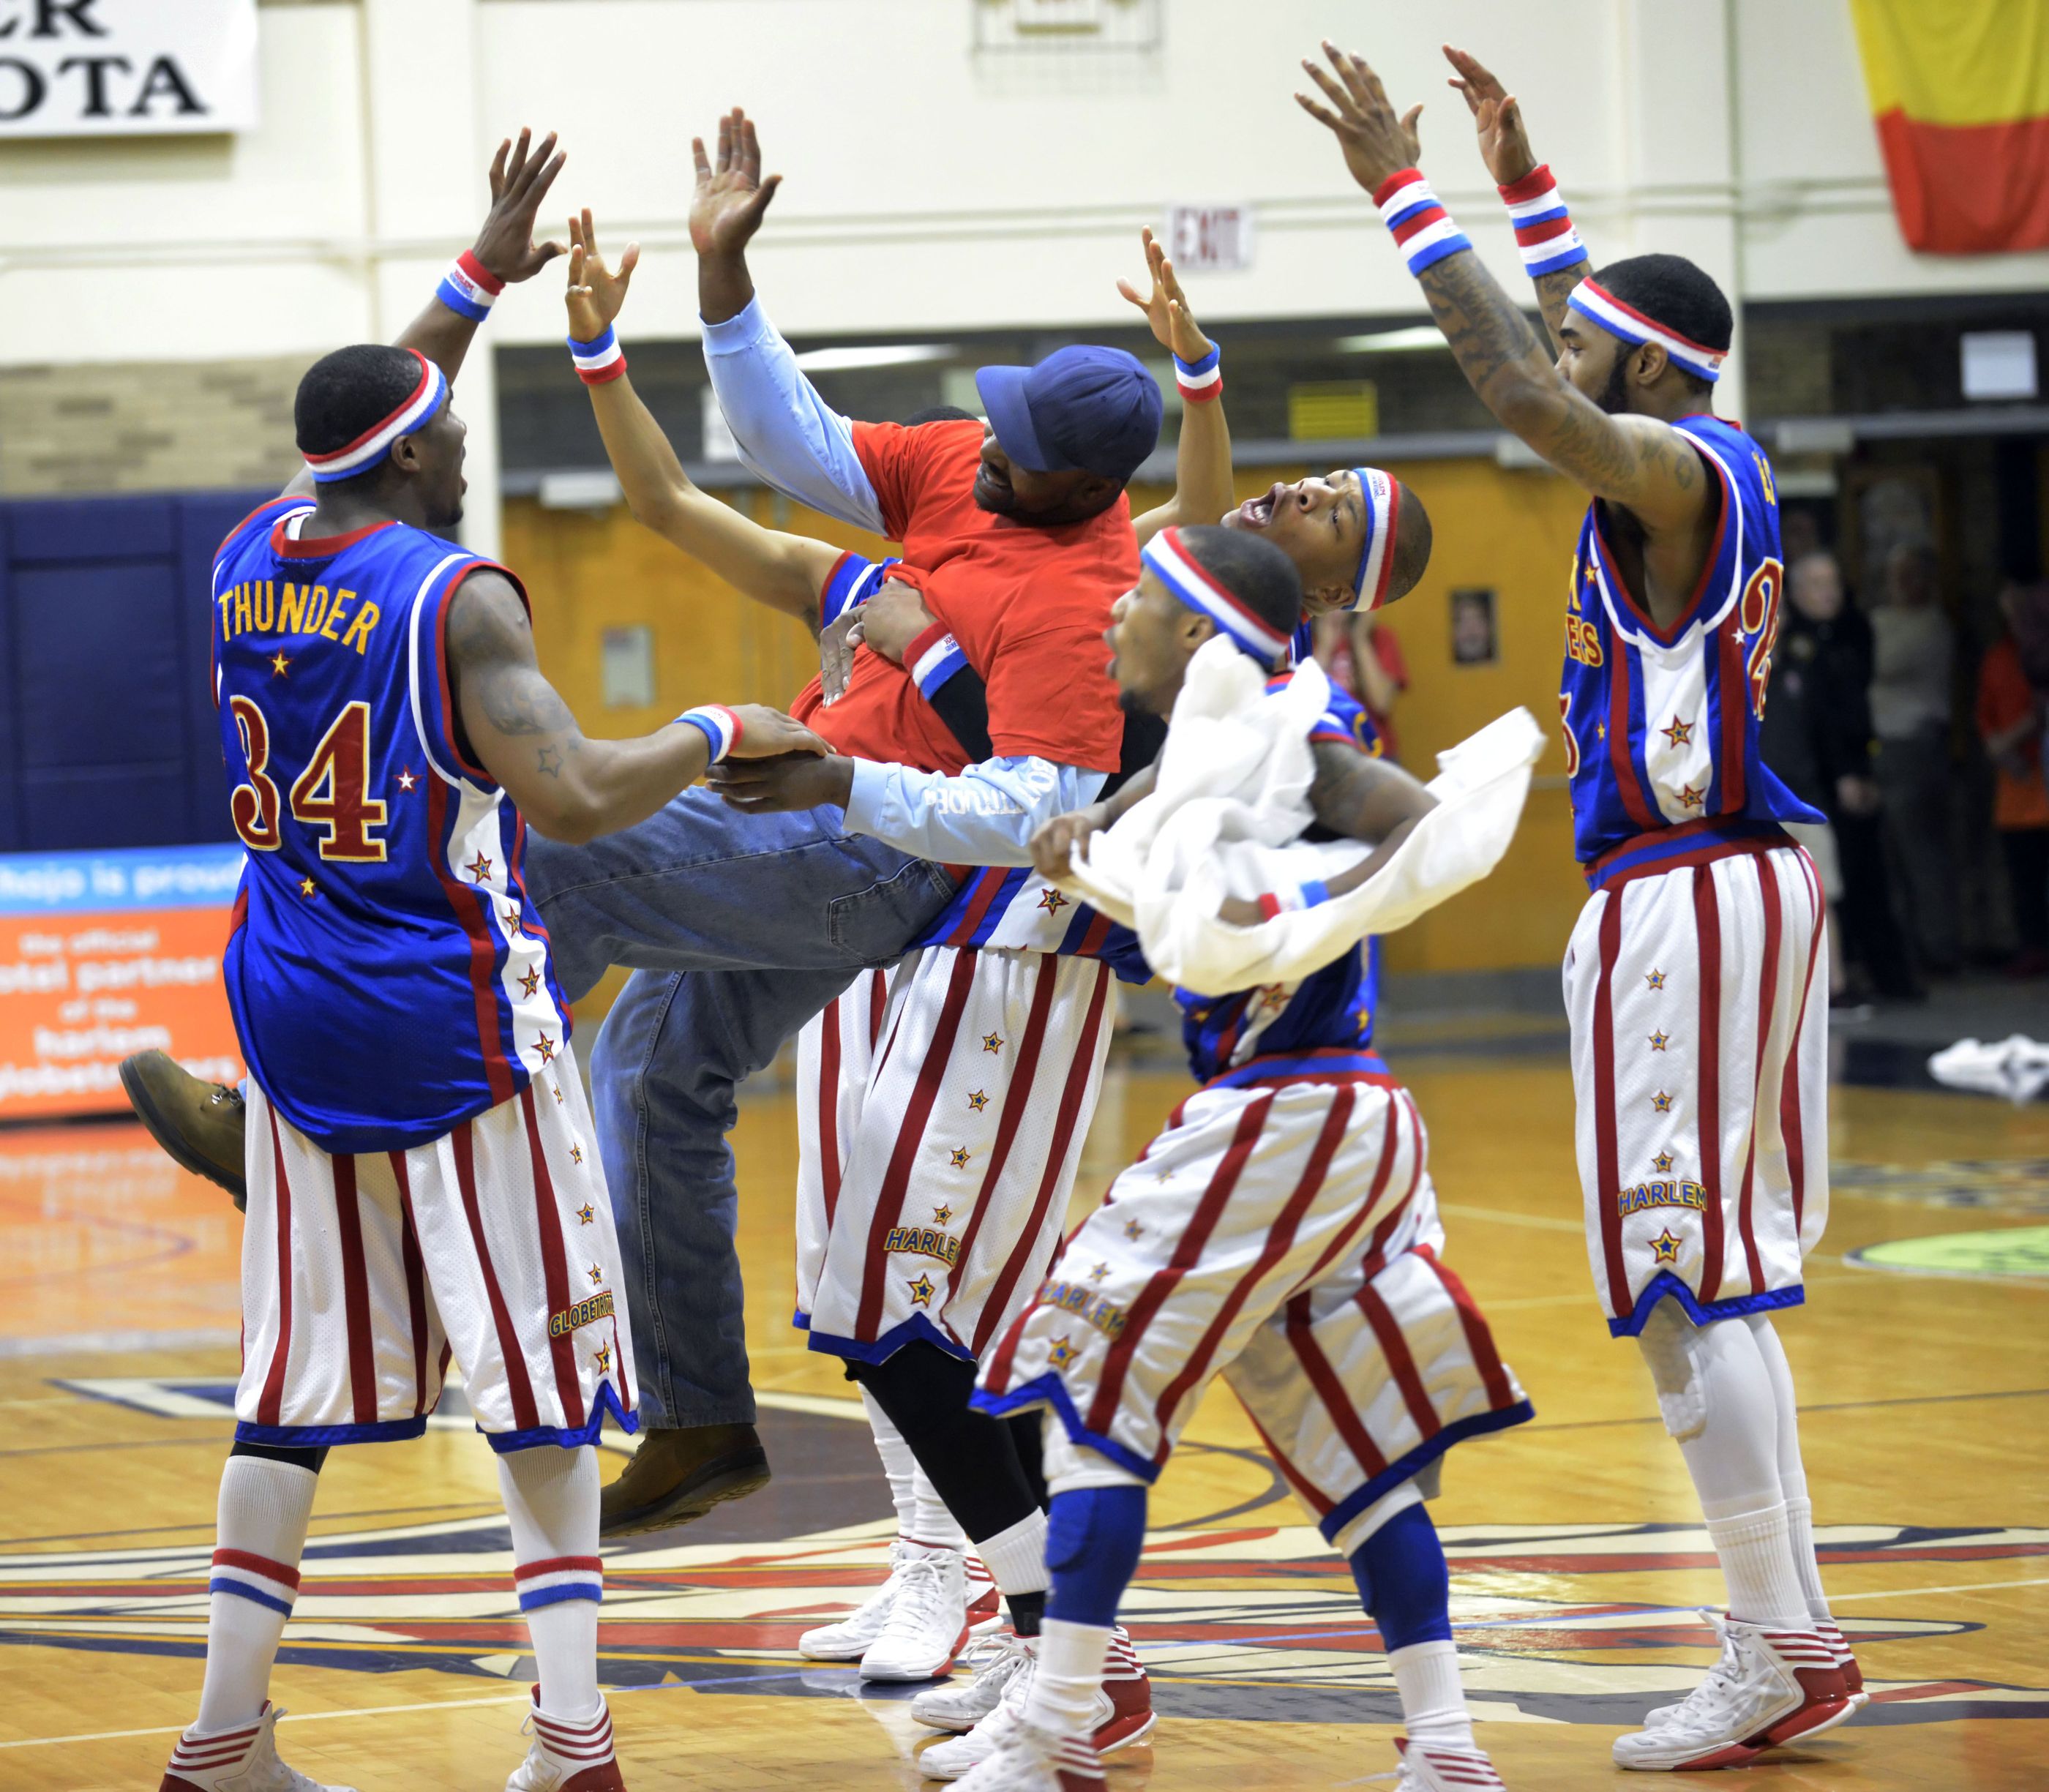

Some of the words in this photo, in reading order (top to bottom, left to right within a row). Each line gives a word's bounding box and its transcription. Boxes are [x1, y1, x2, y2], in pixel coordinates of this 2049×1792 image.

[1174, 208, 1240, 263] EXIT
[219, 580, 380, 655] THUNDER
[230, 694, 388, 862] 34
[77, 953, 217, 997] partner
[34, 1024, 172, 1059] harlem
[1617, 1180, 1707, 1218] HARLEM
